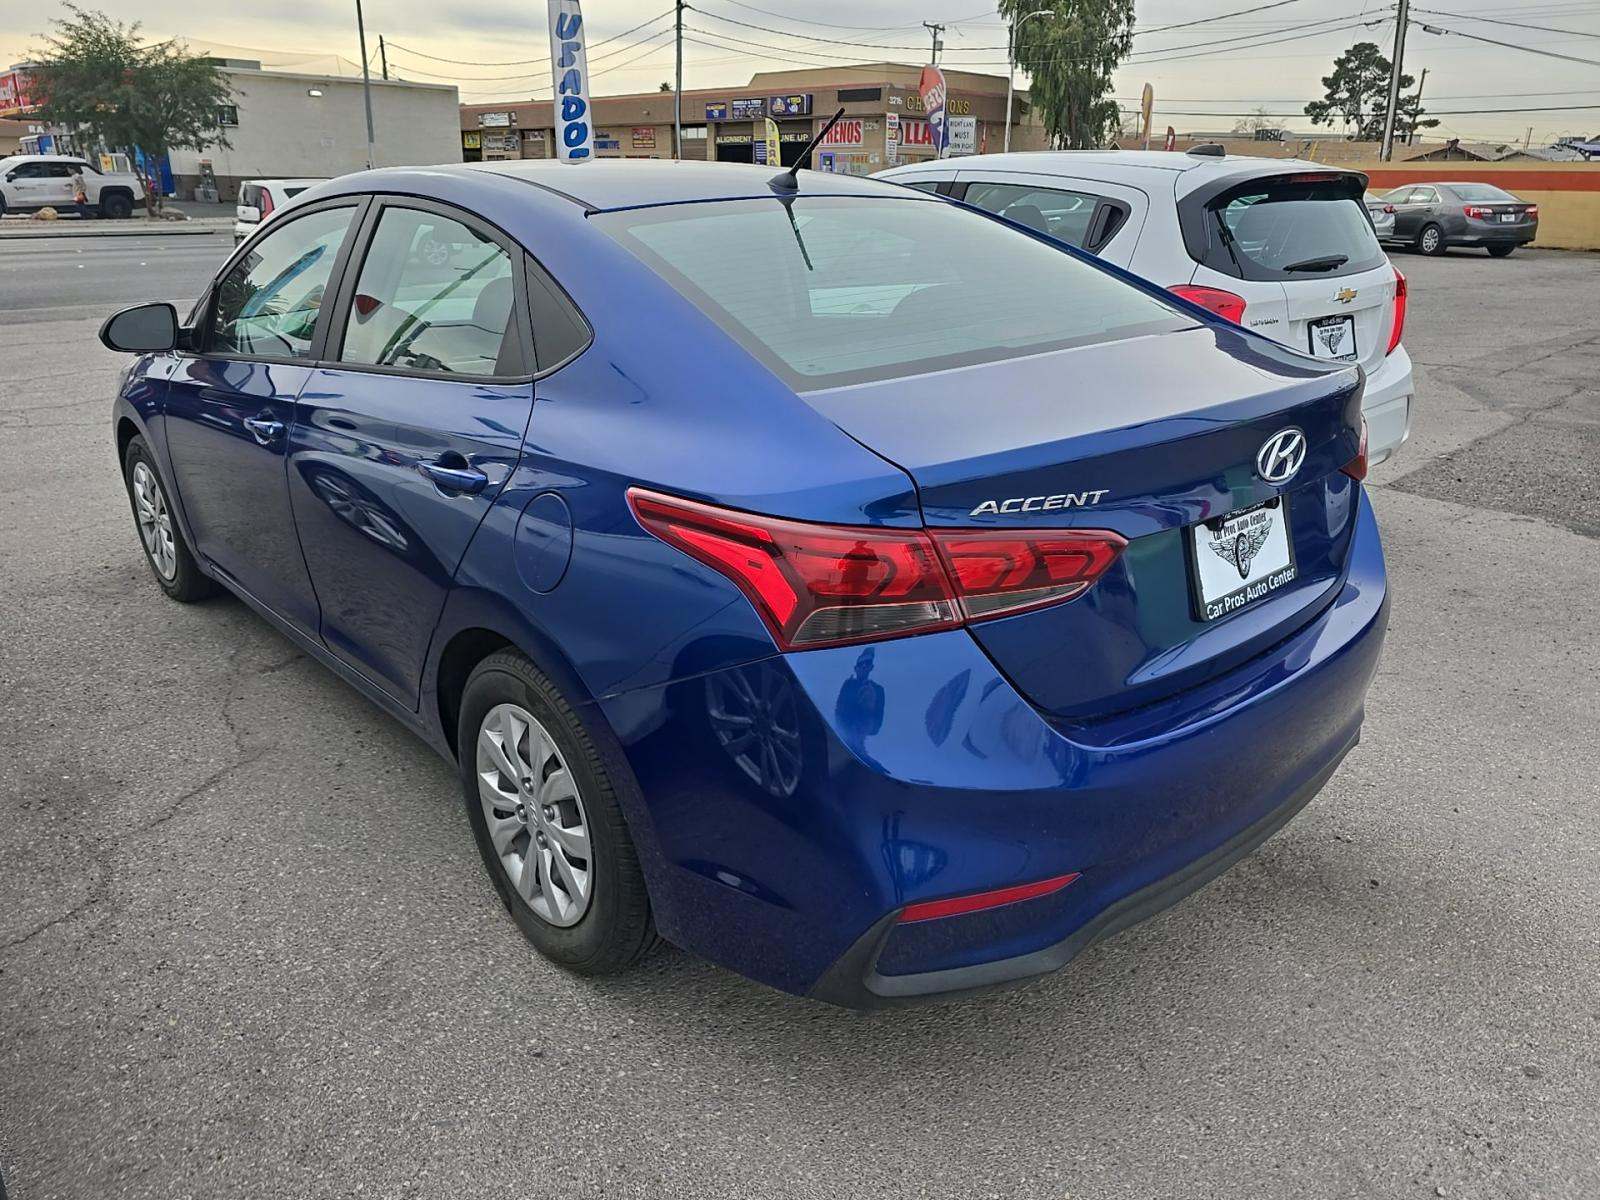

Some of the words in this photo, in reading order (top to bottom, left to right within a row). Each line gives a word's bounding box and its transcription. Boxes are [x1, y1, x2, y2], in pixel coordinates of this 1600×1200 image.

[797, 133, 809, 142] UP
[954, 131, 969, 140] MUST
[969, 489, 1110, 516] ACCENT
[1206, 602, 1223, 620] Car
[1224, 594, 1245, 612] Pros
[1246, 583, 1268, 602] Auto
[1268, 567, 1295, 590] Center
